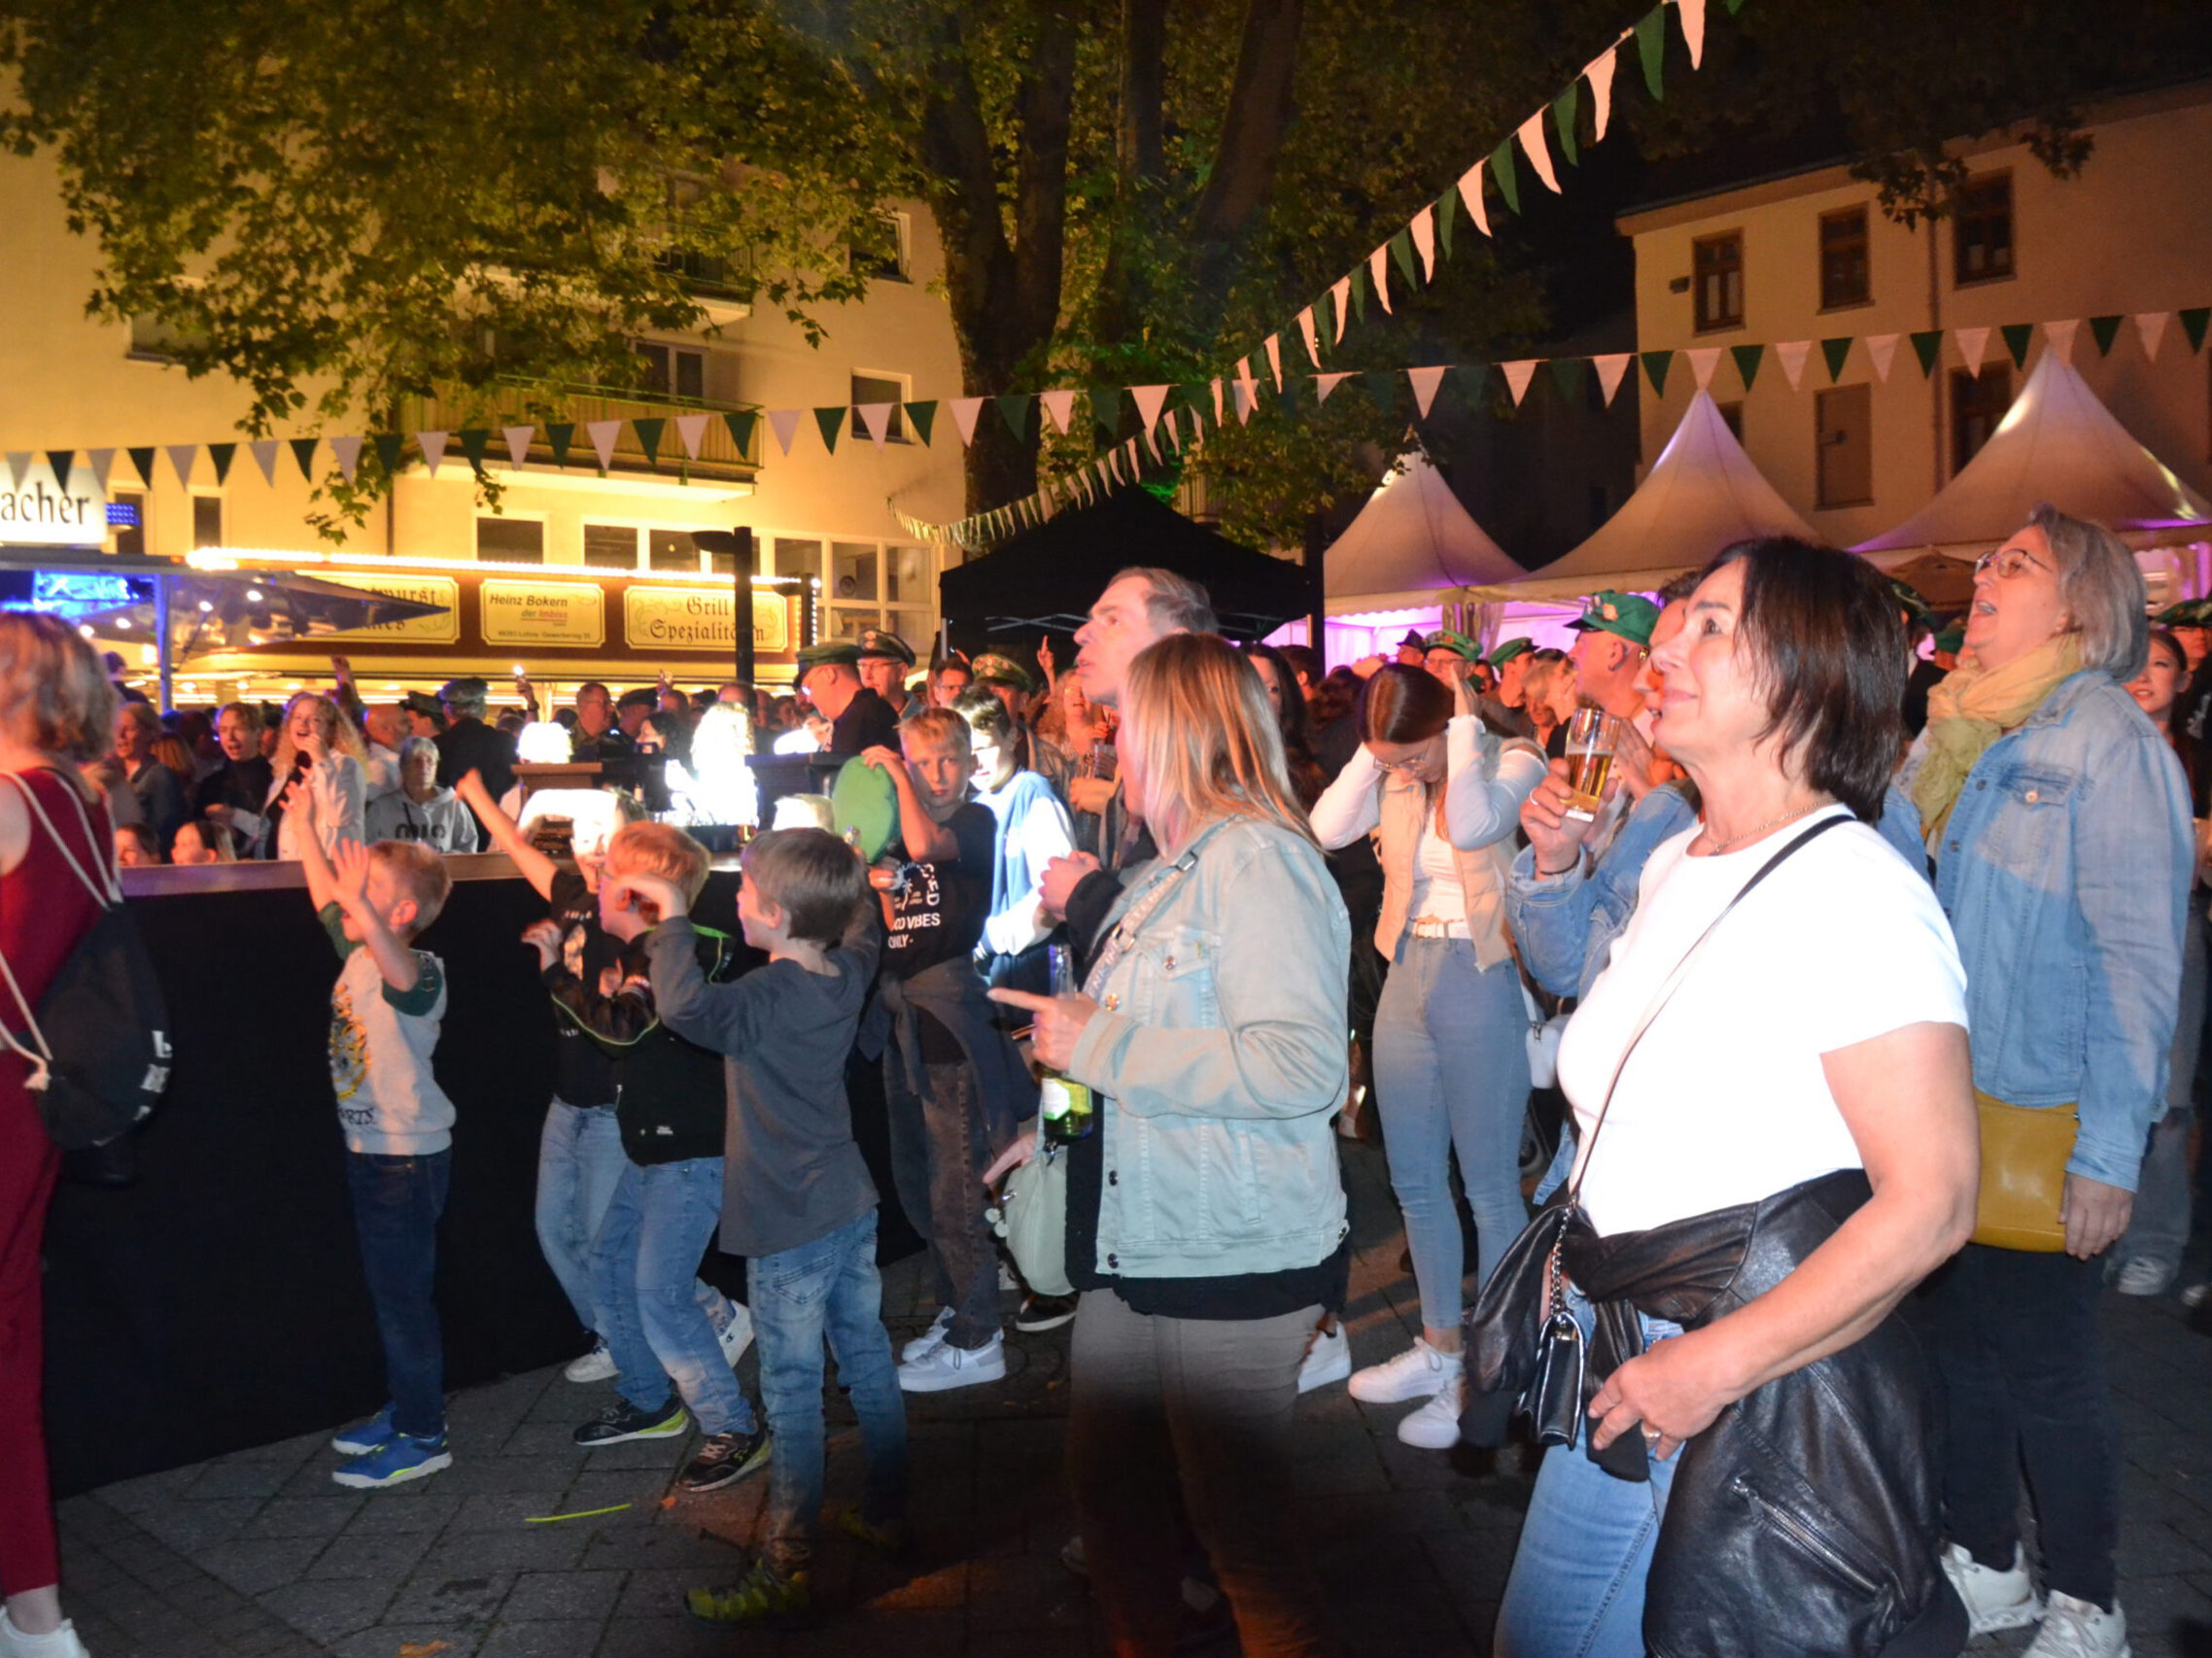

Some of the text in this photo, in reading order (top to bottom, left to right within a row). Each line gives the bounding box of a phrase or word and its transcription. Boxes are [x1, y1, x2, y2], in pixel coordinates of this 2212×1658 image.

[490, 594, 569, 607] Heinz Bokern
[686, 595, 729, 616] Grill
[650, 619, 765, 643] Spezialitän
[907, 913, 941, 929] VIBES
[887, 934, 910, 950] ONLY
